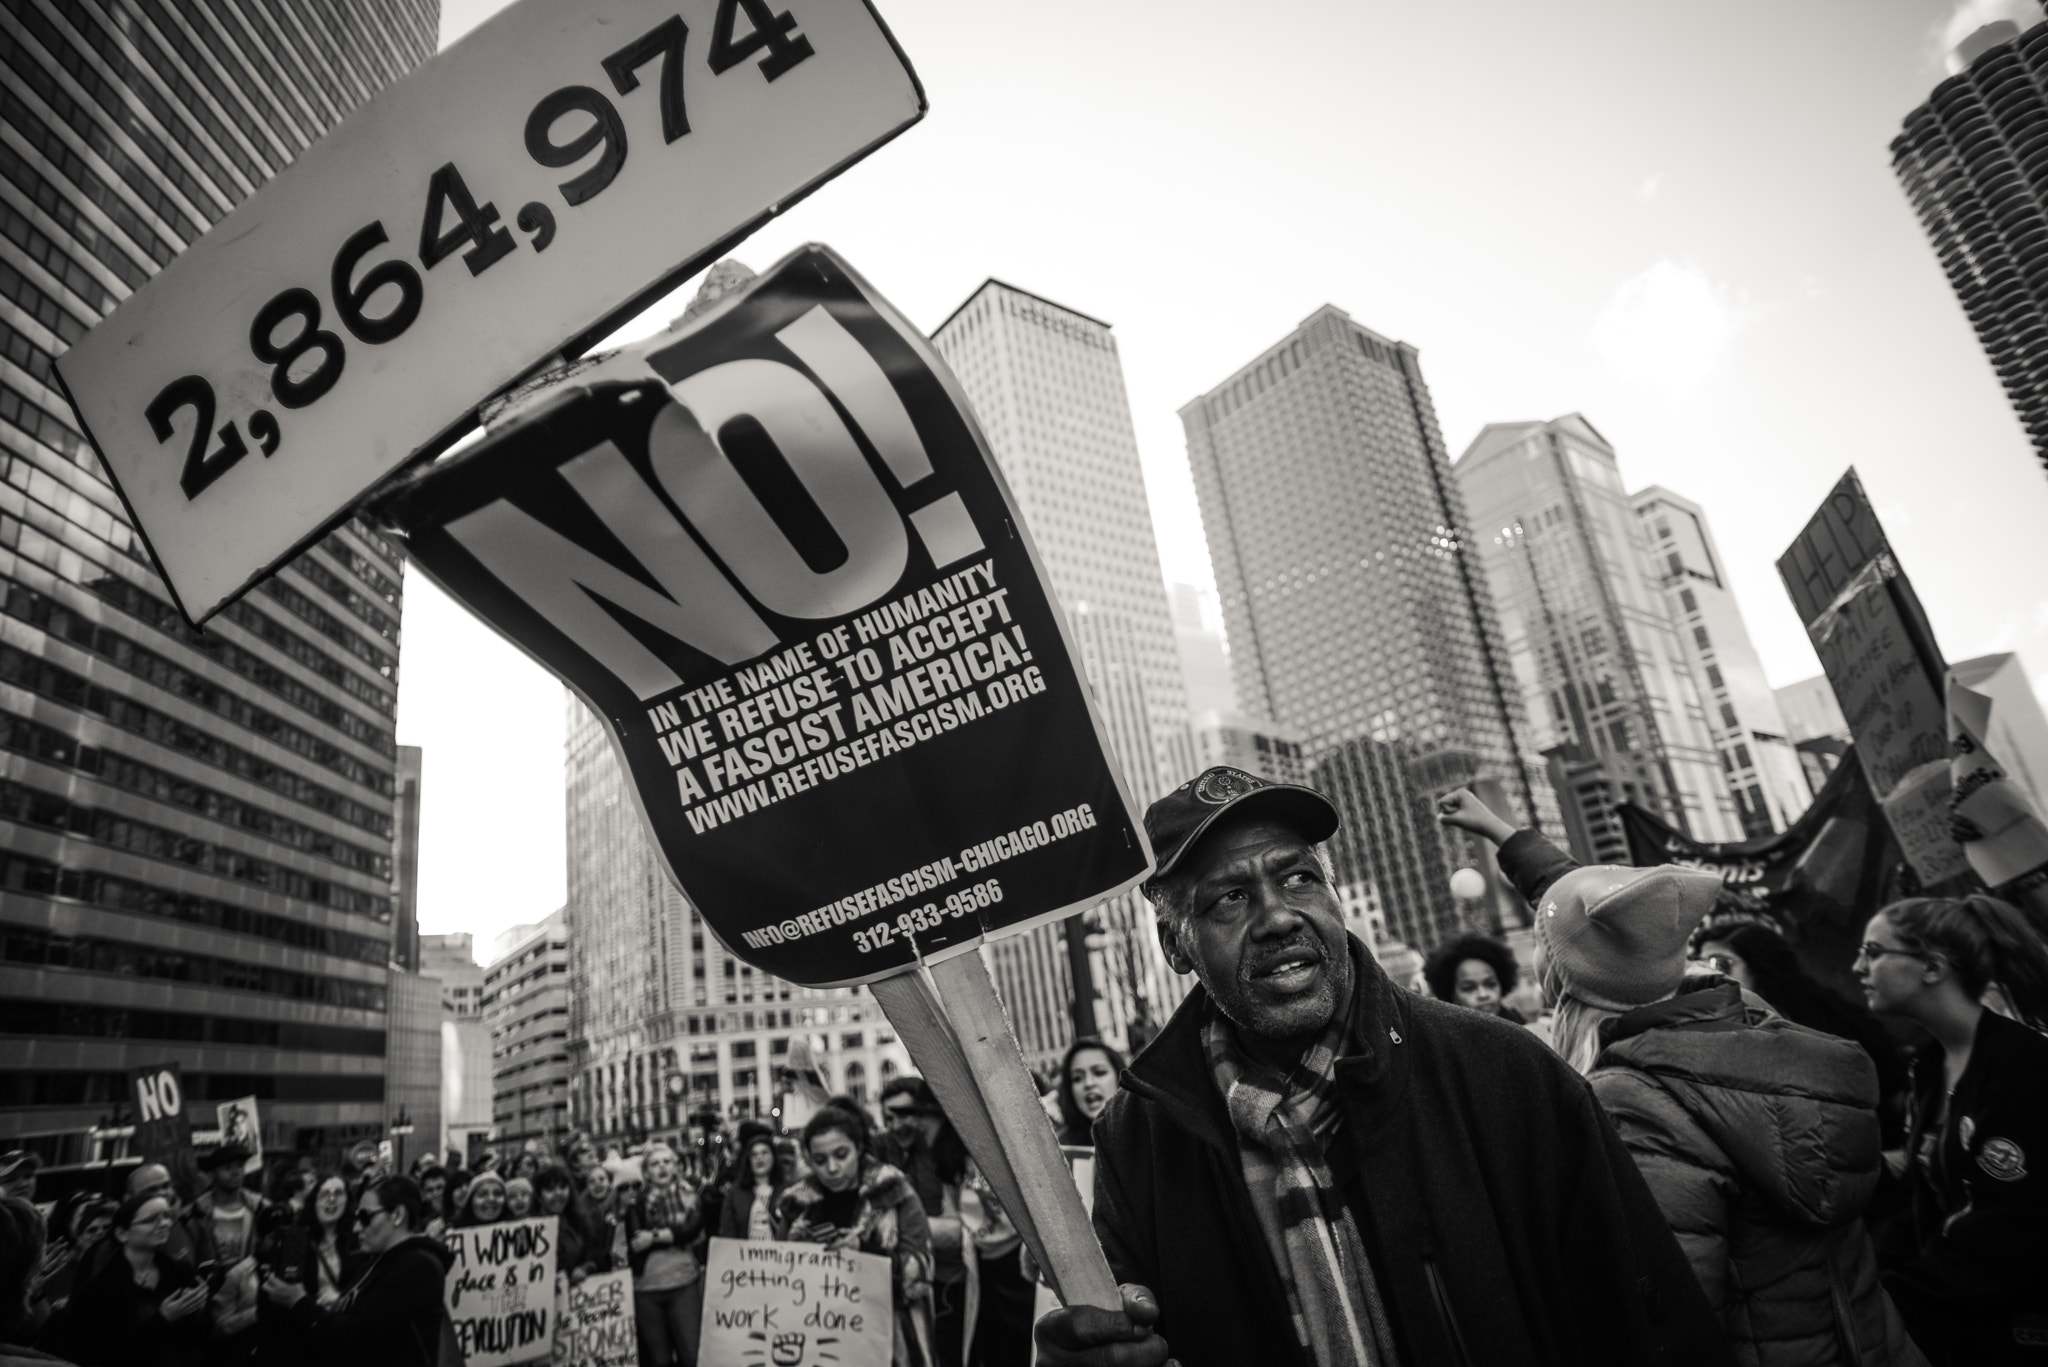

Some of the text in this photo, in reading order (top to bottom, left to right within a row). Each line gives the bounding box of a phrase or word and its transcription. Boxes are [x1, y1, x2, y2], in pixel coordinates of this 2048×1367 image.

[145, 0, 815, 501] 2,864,974
[443, 303, 985, 701] NO!
[1791, 492, 1868, 612] HELP
[647, 559, 1000, 735] IN THE NAME OF HUMANITY
[657, 588, 1015, 767] WE REFUSE TO ACCEPT
[674, 625, 1035, 806] A FASCIST AMERICA!
[685, 665, 1047, 835] WWW.REFUSEFASCISM.ORG
[742, 803, 1097, 949] INFO@REFUSEFASCISM-CHICAGO.ORG
[852, 878, 1004, 954] 312-933-9586
[136, 1070, 182, 1124] NO
[451, 1261, 546, 1309] place is in
[715, 1301, 864, 1332] work done
[721, 1269, 861, 1306] getting the
